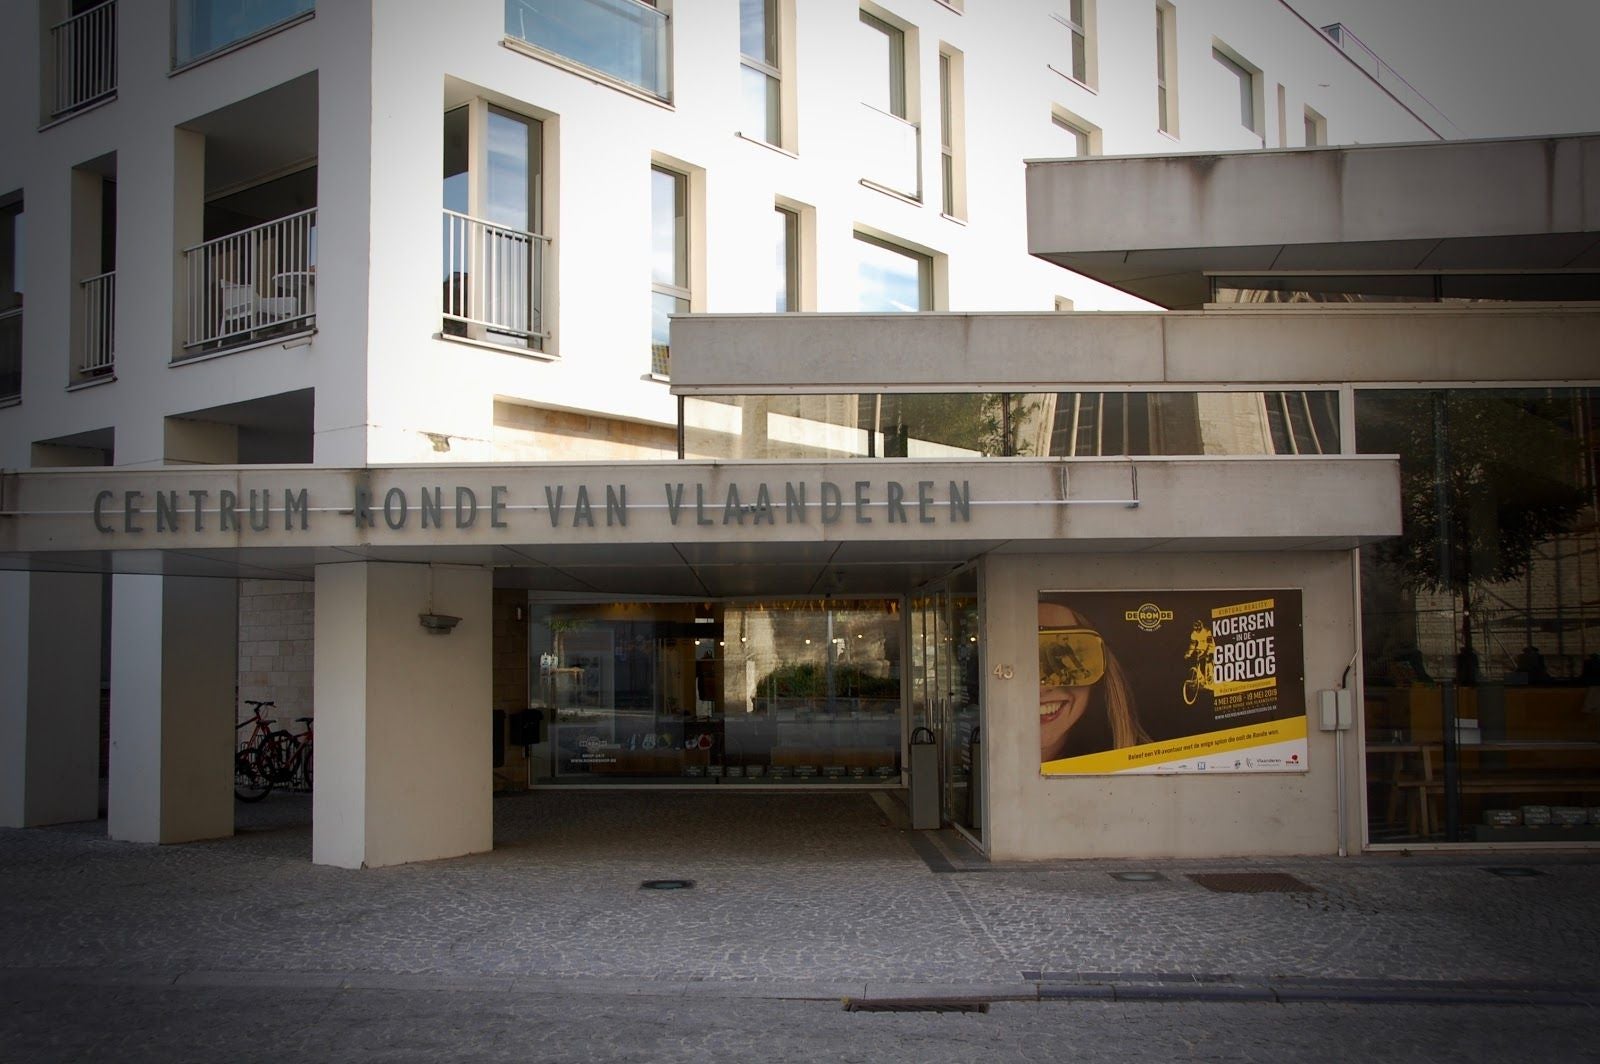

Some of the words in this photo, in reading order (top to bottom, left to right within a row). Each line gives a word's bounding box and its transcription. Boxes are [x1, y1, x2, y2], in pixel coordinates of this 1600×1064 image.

[93, 488, 310, 534] CENTRUM
[354, 485, 509, 530] RONDE
[545, 484, 627, 528] VAN
[664, 480, 972, 526] VLAANDEREN
[1212, 610, 1275, 638] KOERSEN
[1236, 633, 1243, 642] IN
[1243, 632, 1252, 641] DE
[1213, 636, 1276, 665] GROOTE
[1213, 655, 1276, 684] OORLOG
[1218, 696, 1229, 705] MEI
[1254, 690, 1264, 699] MEI
[1128, 751, 1144, 761] Beleef
[1252, 730, 1268, 739] Ronde
